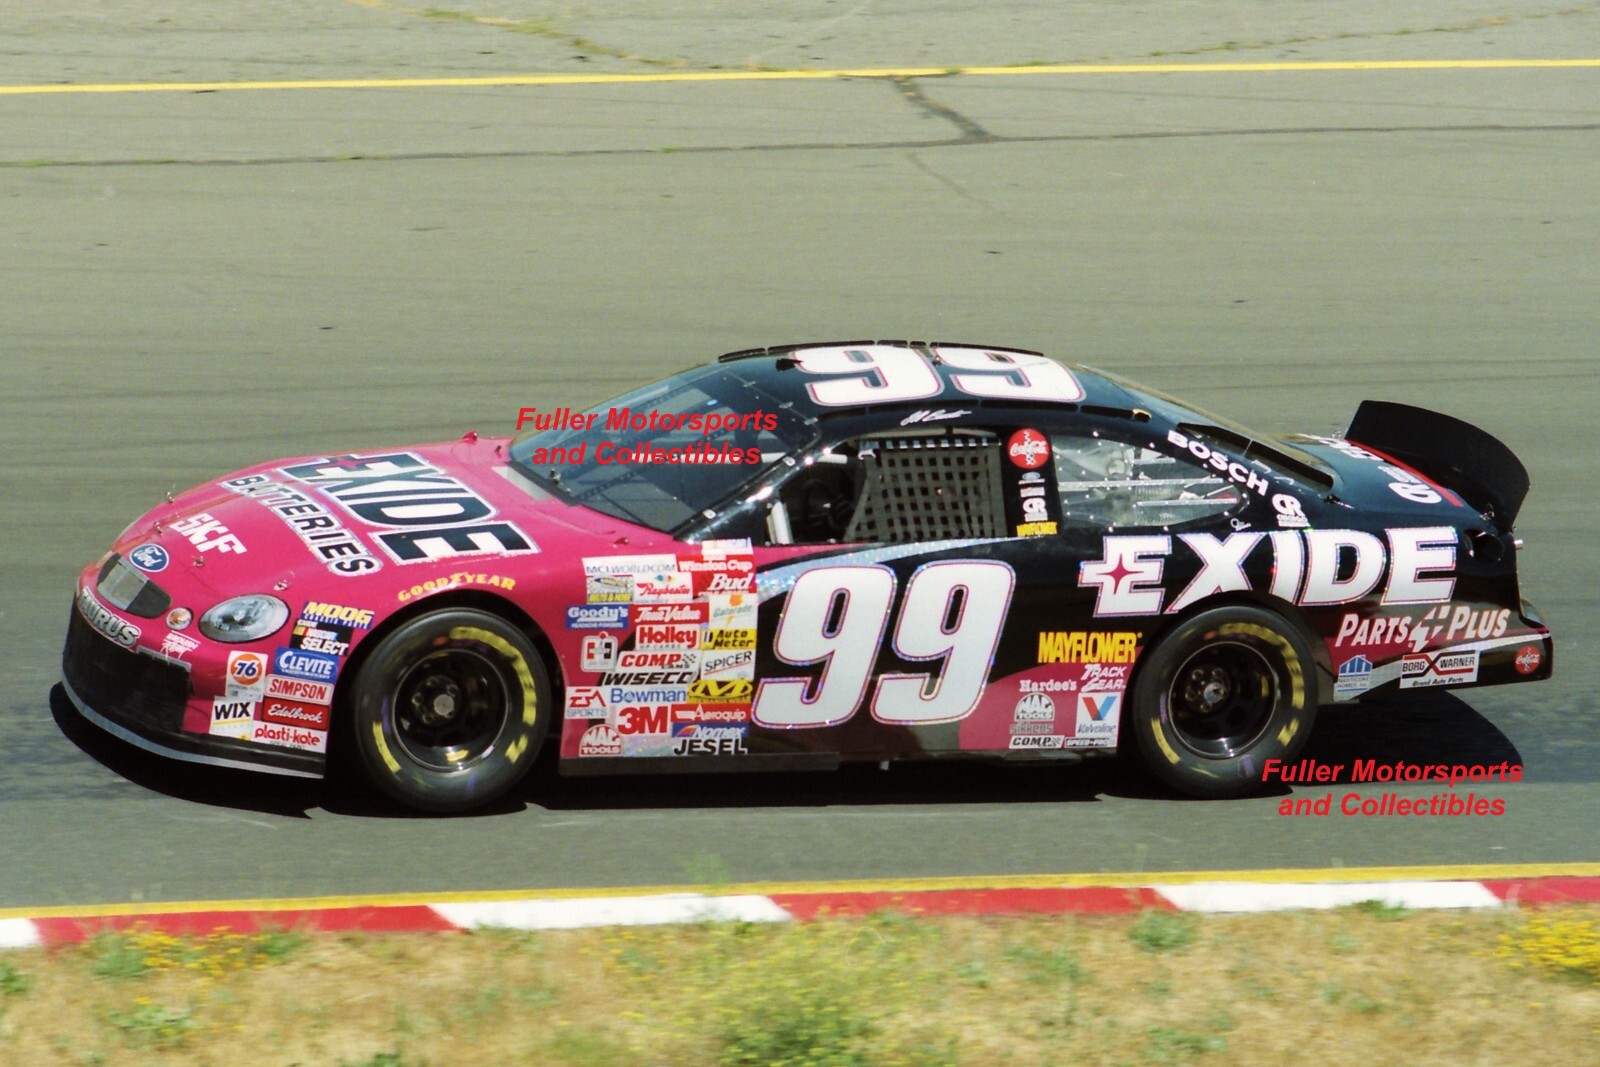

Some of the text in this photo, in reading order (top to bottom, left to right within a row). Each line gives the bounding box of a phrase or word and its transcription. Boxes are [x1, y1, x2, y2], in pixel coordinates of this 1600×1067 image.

[792, 344, 1087, 408] 99
[1166, 429, 1269, 496] BOSCH
[274, 450, 542, 567] EXIDE
[169, 512, 247, 555] SKF
[678, 559, 753, 572] Winston Cup
[1078, 525, 1460, 617] EXIDE
[397, 571, 518, 602] GOODYEAR
[707, 572, 754, 590] Bud
[303, 602, 374, 625] MOOG
[568, 606, 628, 624] Goody's
[635, 605, 701, 622] True Value
[718, 630, 748, 639] Auto
[1335, 606, 1511, 647] PARTS PLUS
[300, 637, 349, 656] SELECT
[639, 627, 697, 649] Holley
[714, 640, 753, 648] Meter
[752, 558, 1017, 730] 99
[1038, 632, 1137, 663] MAYFLOWER
[235, 659, 259, 677] 76
[279, 650, 335, 675] CLEVITE
[621, 653, 682, 667] COMP
[705, 651, 752, 672] SPICER
[1402, 657, 1475, 672] BORG WARNER
[602, 672, 697, 686] WISECO
[1081, 664, 1127, 680] TRACK
[270, 679, 327, 699] SIMPSON
[610, 687, 686, 703] Bowman
[1019, 680, 1077, 692] Hardee's
[215, 702, 250, 720] WIX
[1018, 694, 1053, 711] MAC
[268, 704, 323, 723] Edelbrock
[567, 708, 608, 718] SPORTS
[617, 706, 672, 735] 3M
[693, 703, 747, 722] Aeroquip
[1017, 711, 1052, 720] TOOLS
[255, 724, 320, 746] plasti-kote
[583, 727, 620, 744] MAC
[694, 725, 746, 738] Nomex
[1078, 723, 1116, 734] Valvoline
[582, 746, 620, 754] TOOLS
[673, 738, 748, 755] JESEL
[1012, 737, 1051, 746] COMP
